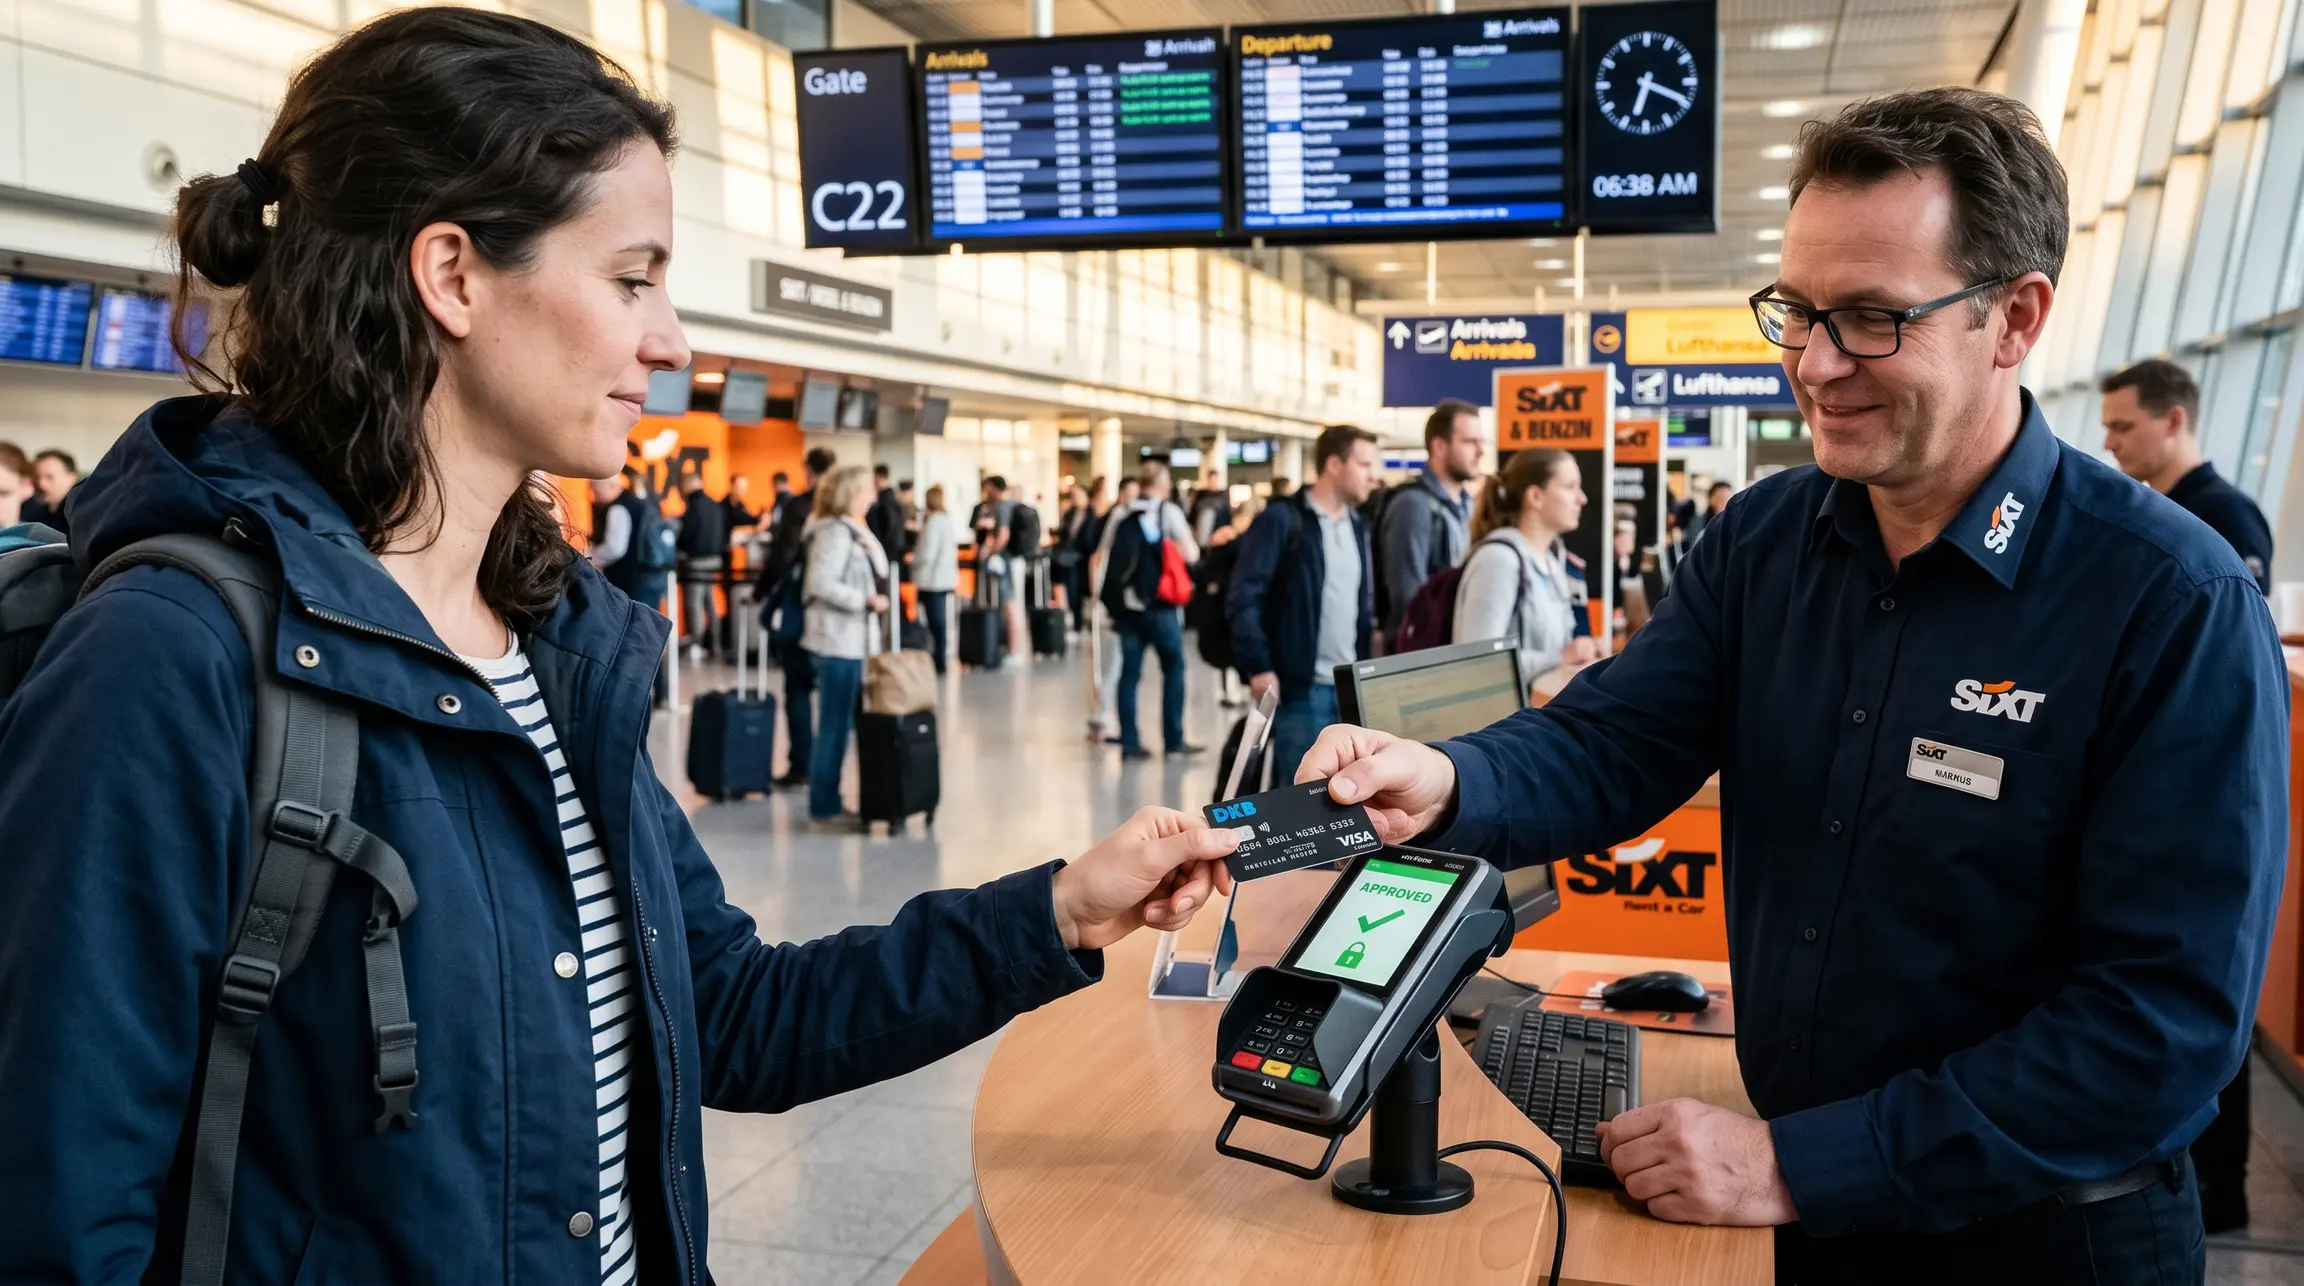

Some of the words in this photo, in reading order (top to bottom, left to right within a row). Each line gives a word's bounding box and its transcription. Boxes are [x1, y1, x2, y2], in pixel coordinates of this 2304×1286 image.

[1241, 34, 1333, 56] Departure
[925, 49, 988, 70] Arrivals
[804, 67, 867, 96] Gate
[1593, 174, 1655, 198] 06:38
[1657, 172, 1697, 196] AM
[811, 180, 907, 232] C22
[1212, 801, 1257, 823] DKB
[1335, 831, 1375, 847] VISA
[1359, 882, 1433, 903] APPROVED
[1624, 900, 1659, 912] Rent
[1678, 902, 1705, 914] Car
